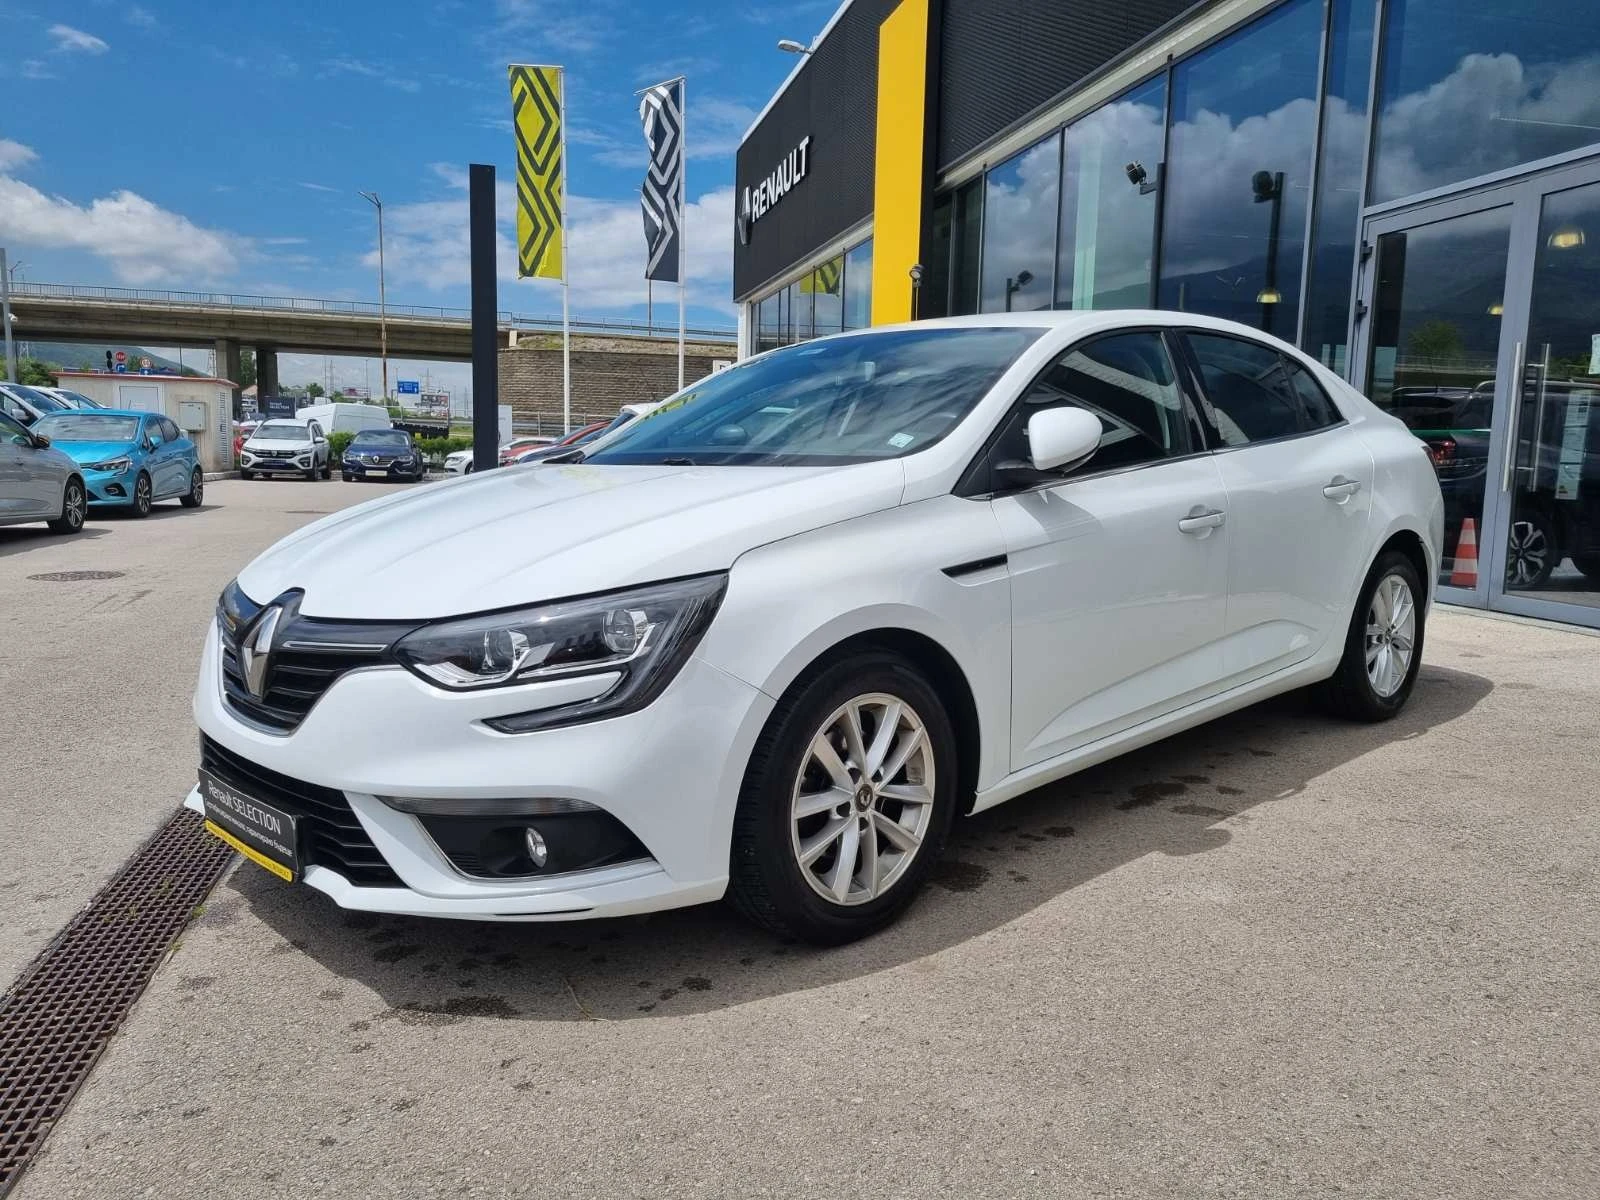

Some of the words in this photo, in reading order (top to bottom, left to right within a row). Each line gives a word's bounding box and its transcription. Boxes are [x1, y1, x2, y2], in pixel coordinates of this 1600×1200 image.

[752, 136, 810, 223] RENAULT
[208, 780, 233, 810] Renault
[233, 798, 281, 835] SELECTION
